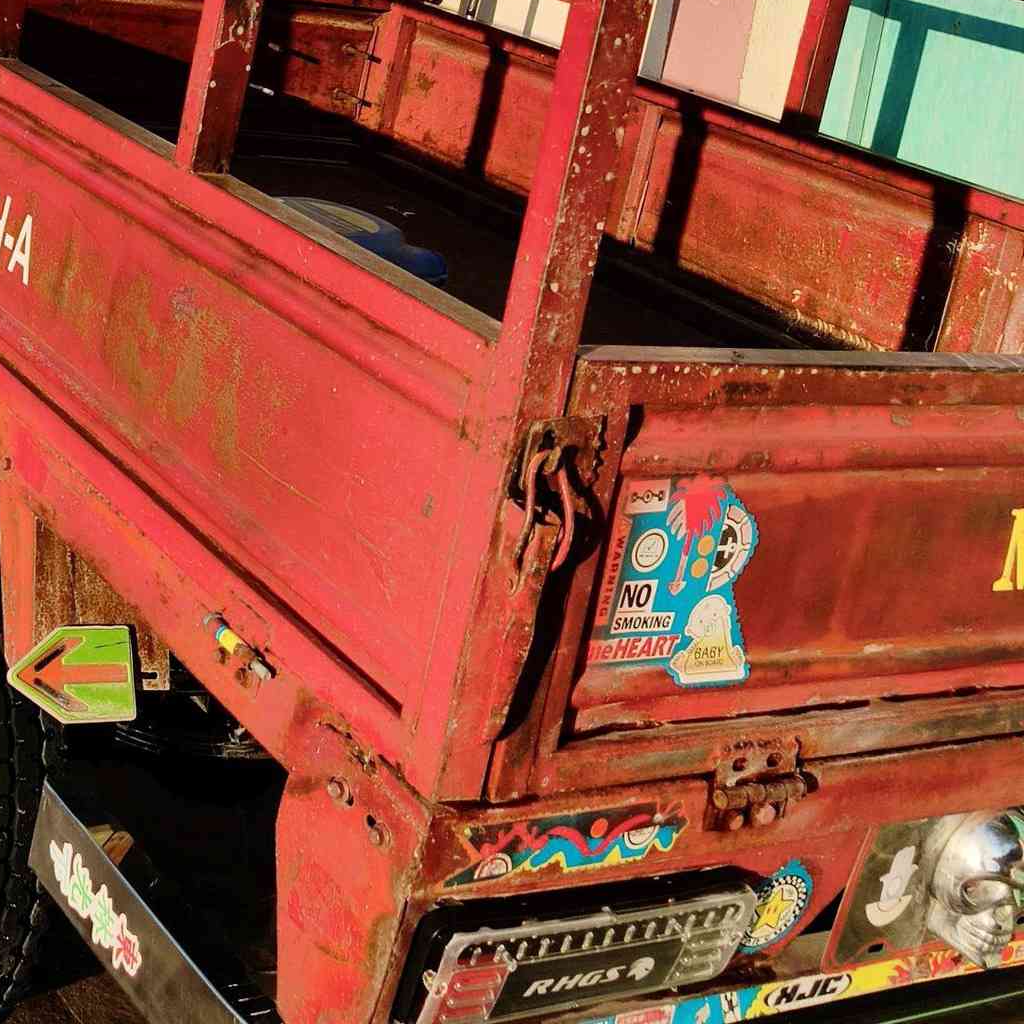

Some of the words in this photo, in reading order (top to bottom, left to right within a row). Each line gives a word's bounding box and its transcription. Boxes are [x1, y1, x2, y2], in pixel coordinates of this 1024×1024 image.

[620, 584, 652, 608] NO
[613, 615, 671, 631] SMOKING
[694, 645, 724, 660] BABY
[523, 965, 626, 997] RHGS
[775, 974, 847, 1005] HJC
